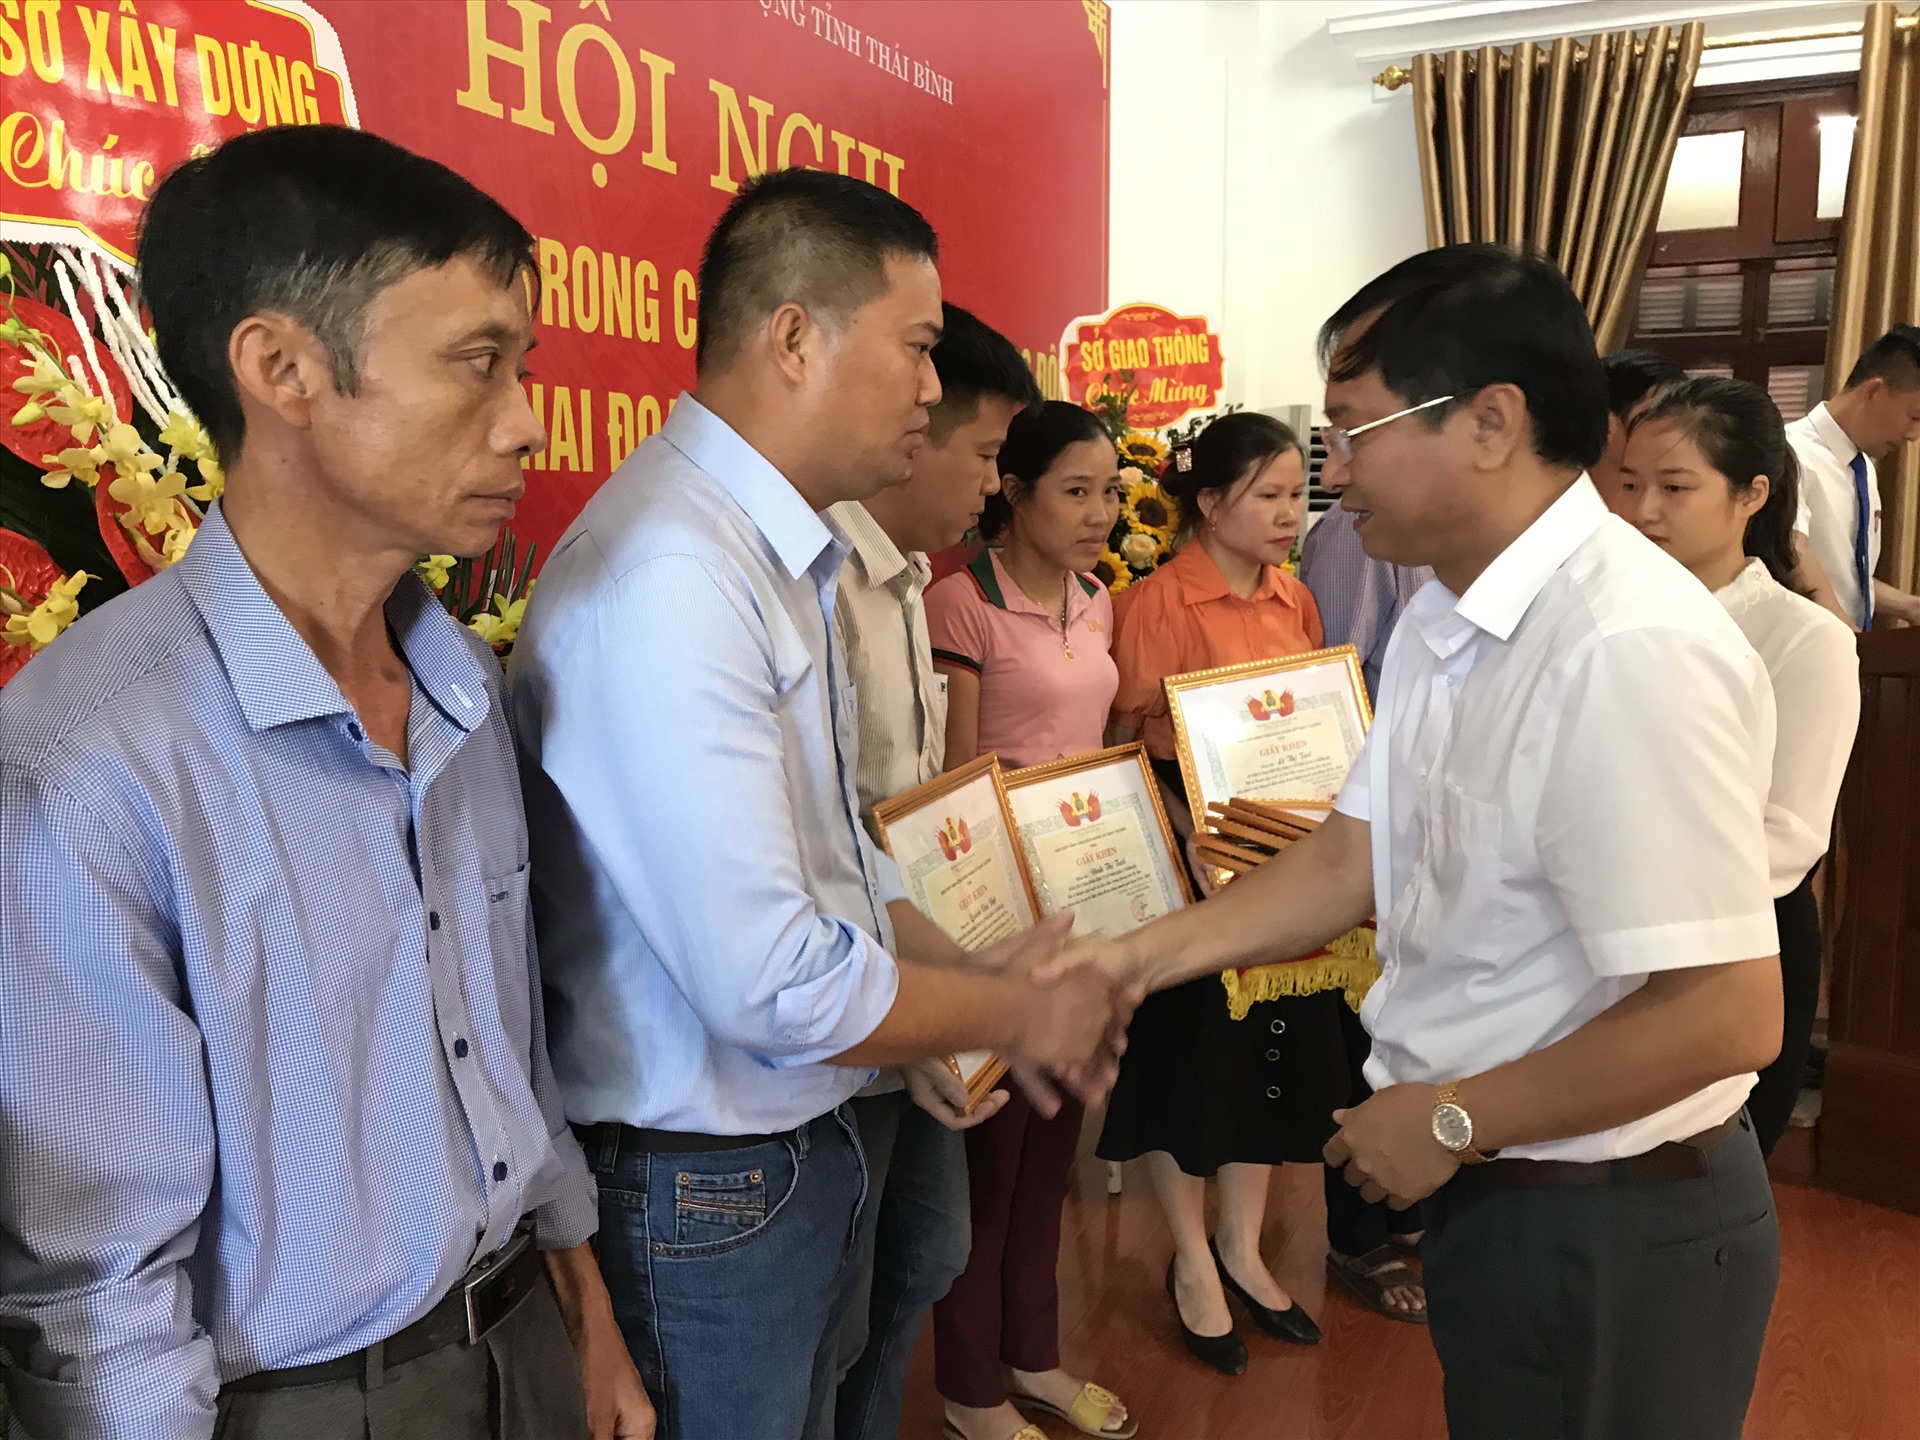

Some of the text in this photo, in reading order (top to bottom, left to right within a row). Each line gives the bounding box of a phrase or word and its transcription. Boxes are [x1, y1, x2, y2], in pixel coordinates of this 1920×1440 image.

[76, 0, 179, 107] XÂY
[194, 34, 320, 133] DỰNG
[456, 0, 677, 189] HỘI
[811, 2, 861, 57] TỈNH
[865, 35, 909, 82] THÁI
[913, 60, 954, 105] BÌNH
[0, 111, 155, 202] Chúc
[522, 236, 661, 343] RONG
[1080, 327, 1210, 372] SỞ GIAO THÔNG
[1144, 377, 1210, 406] Mừng
